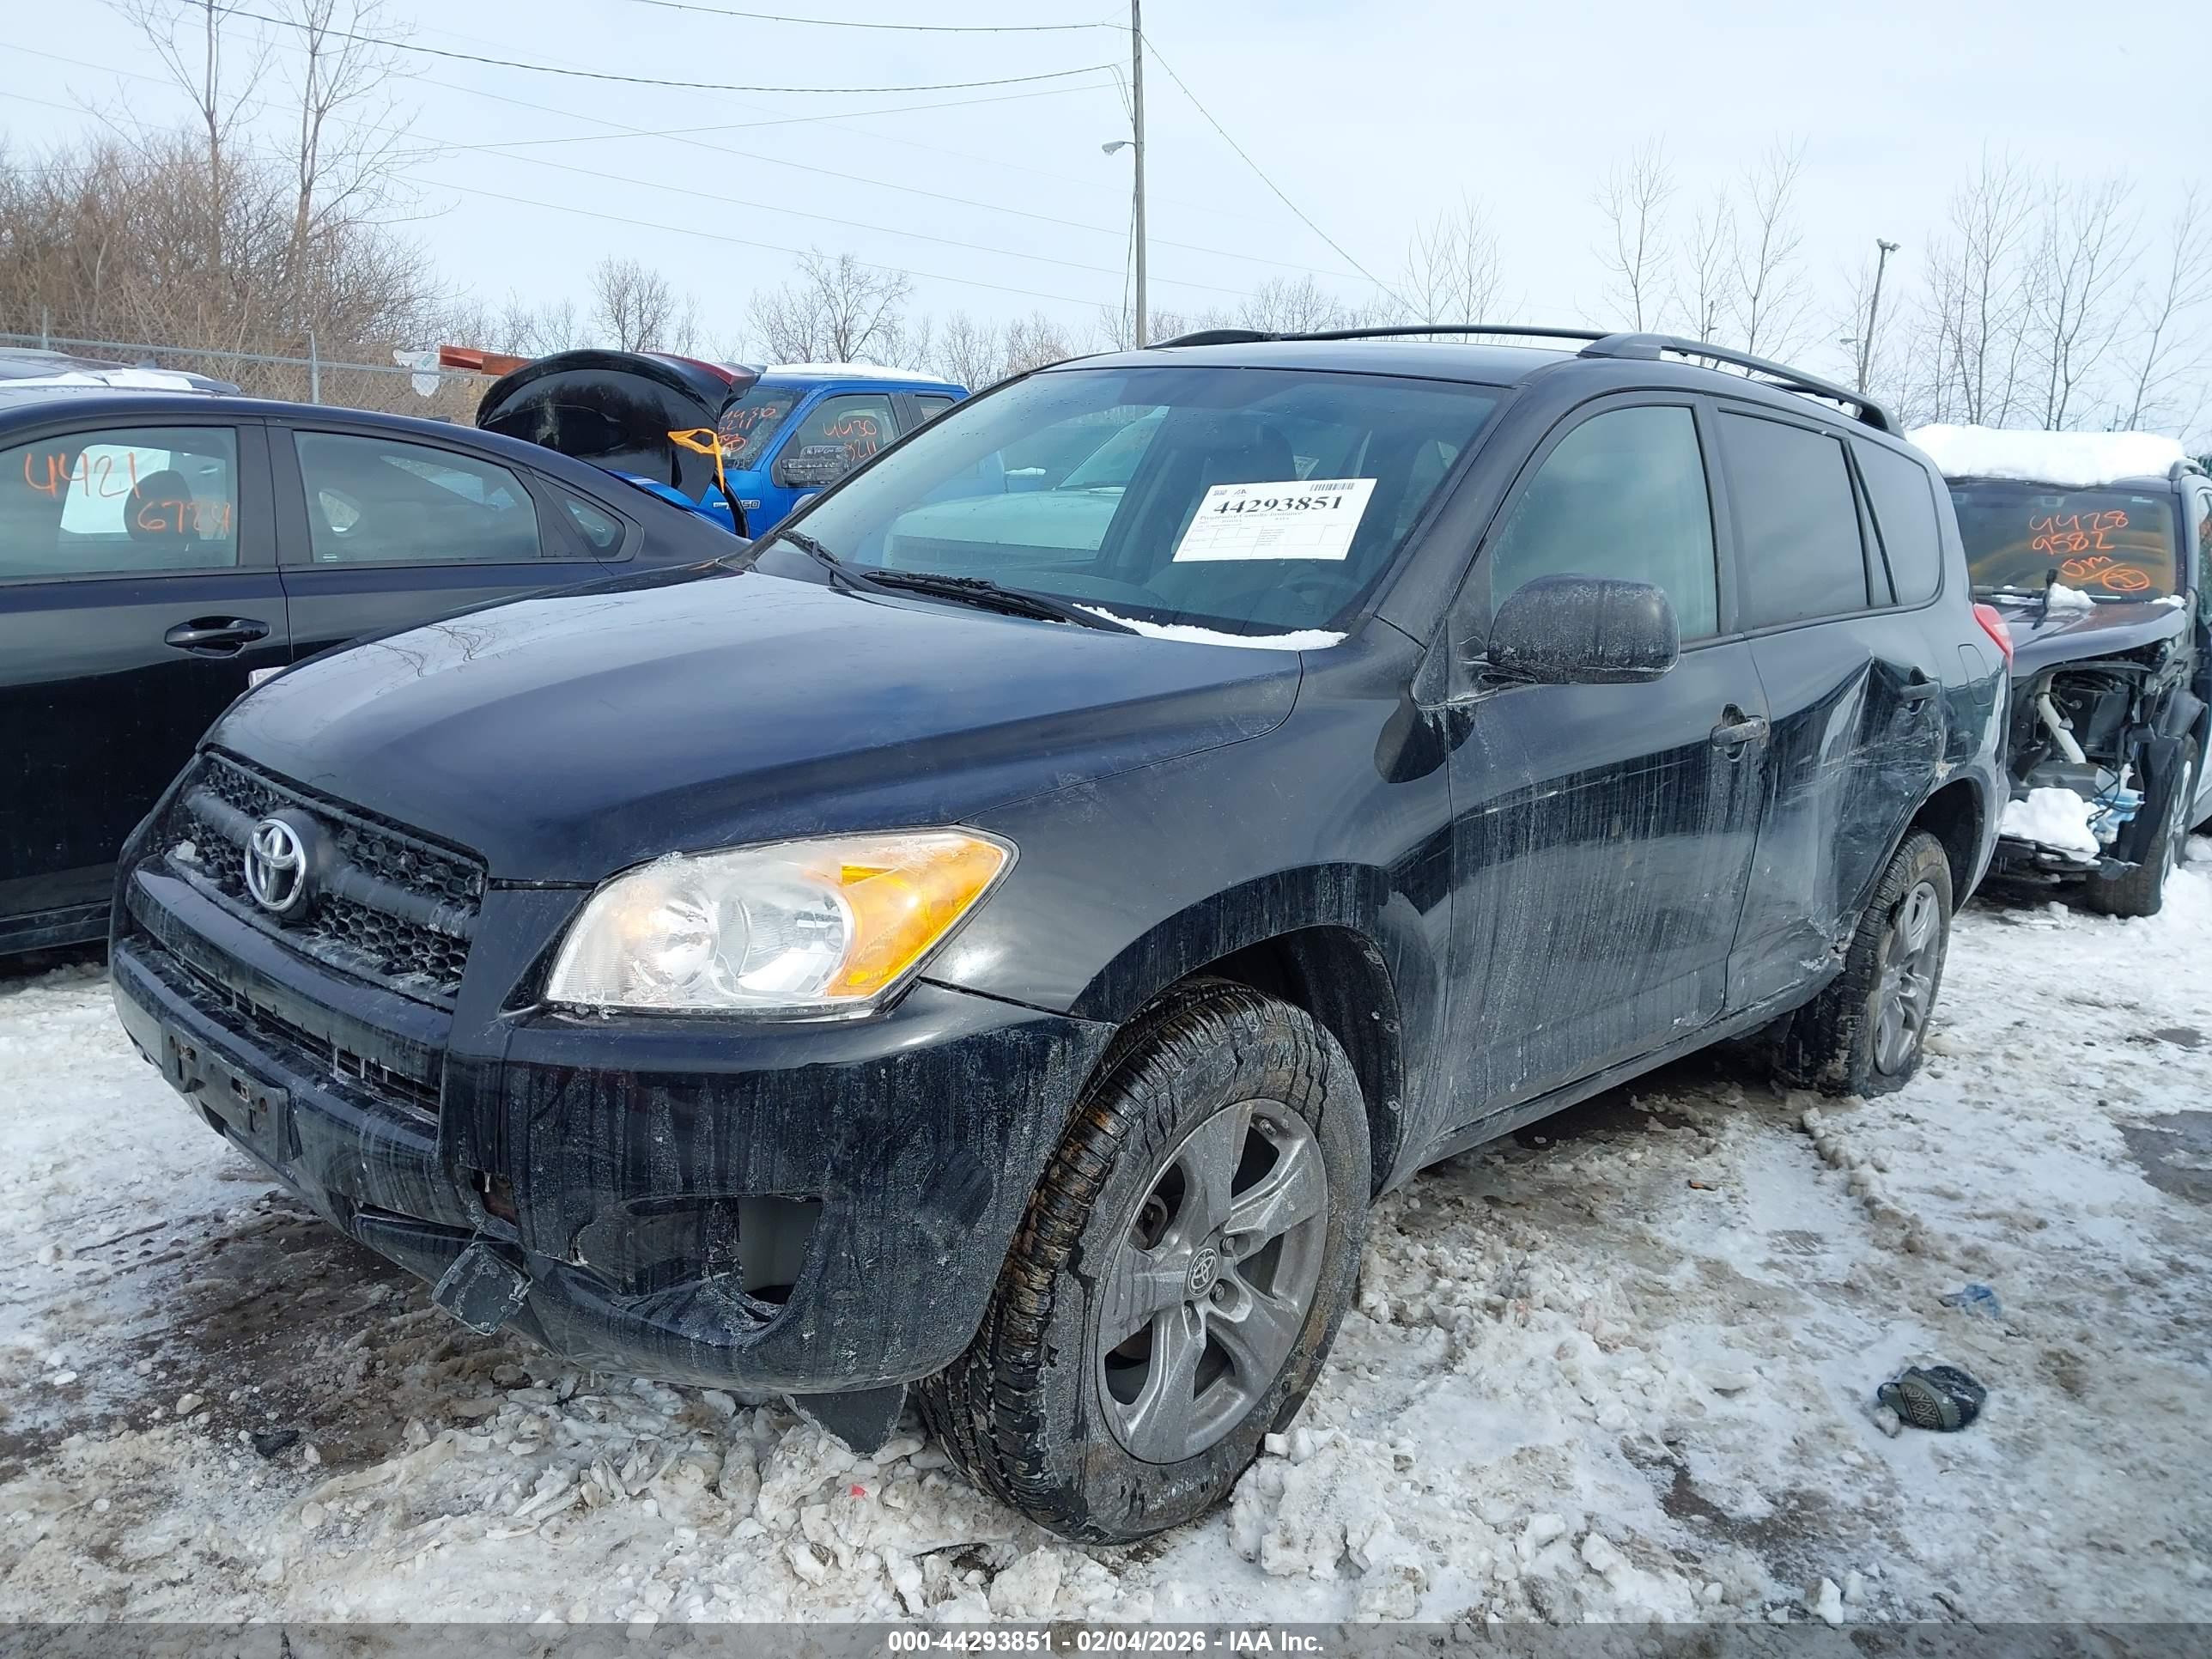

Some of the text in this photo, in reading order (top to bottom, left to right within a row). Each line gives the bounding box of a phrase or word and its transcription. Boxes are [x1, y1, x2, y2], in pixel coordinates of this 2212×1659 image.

[823, 420, 877, 439] 4430
[23, 451, 141, 499] 4421
[1213, 495, 1343, 515] 44293851
[2029, 509, 2130, 533] 4428
[2032, 531, 2116, 556] 9582
